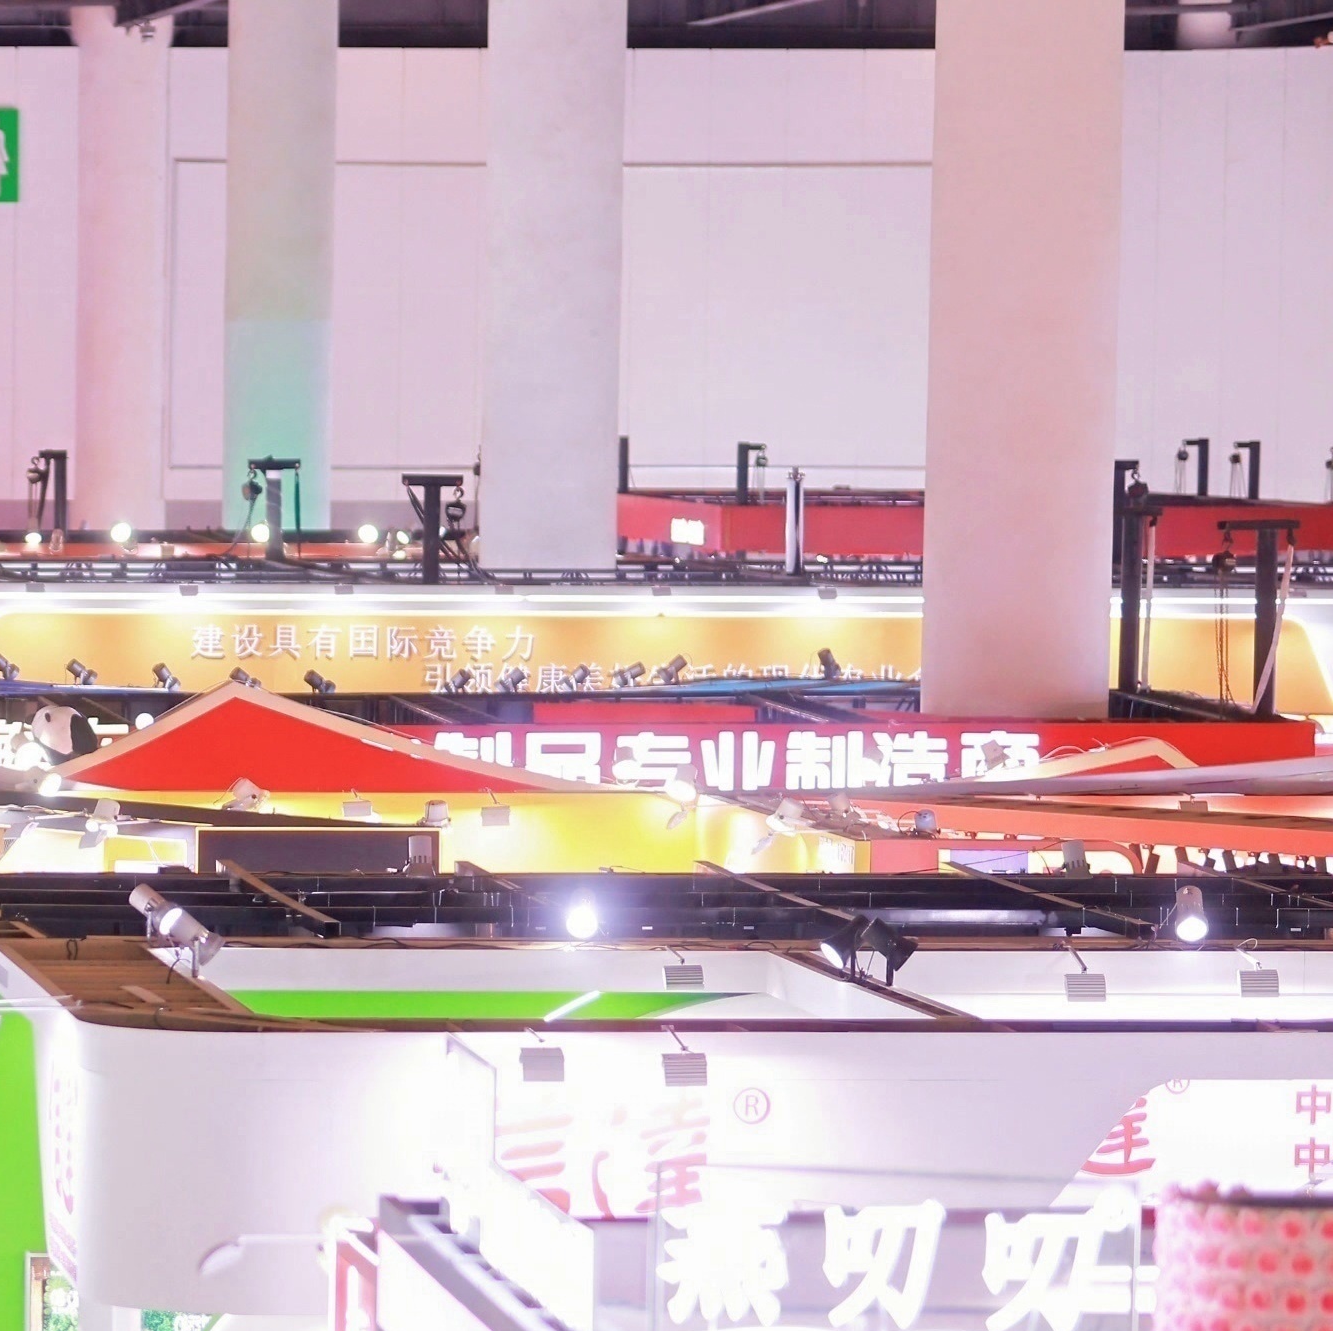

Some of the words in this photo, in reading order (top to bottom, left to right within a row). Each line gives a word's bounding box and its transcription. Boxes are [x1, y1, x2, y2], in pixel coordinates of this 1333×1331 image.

[191, 624, 535, 660] 建设具有国际竞争力
